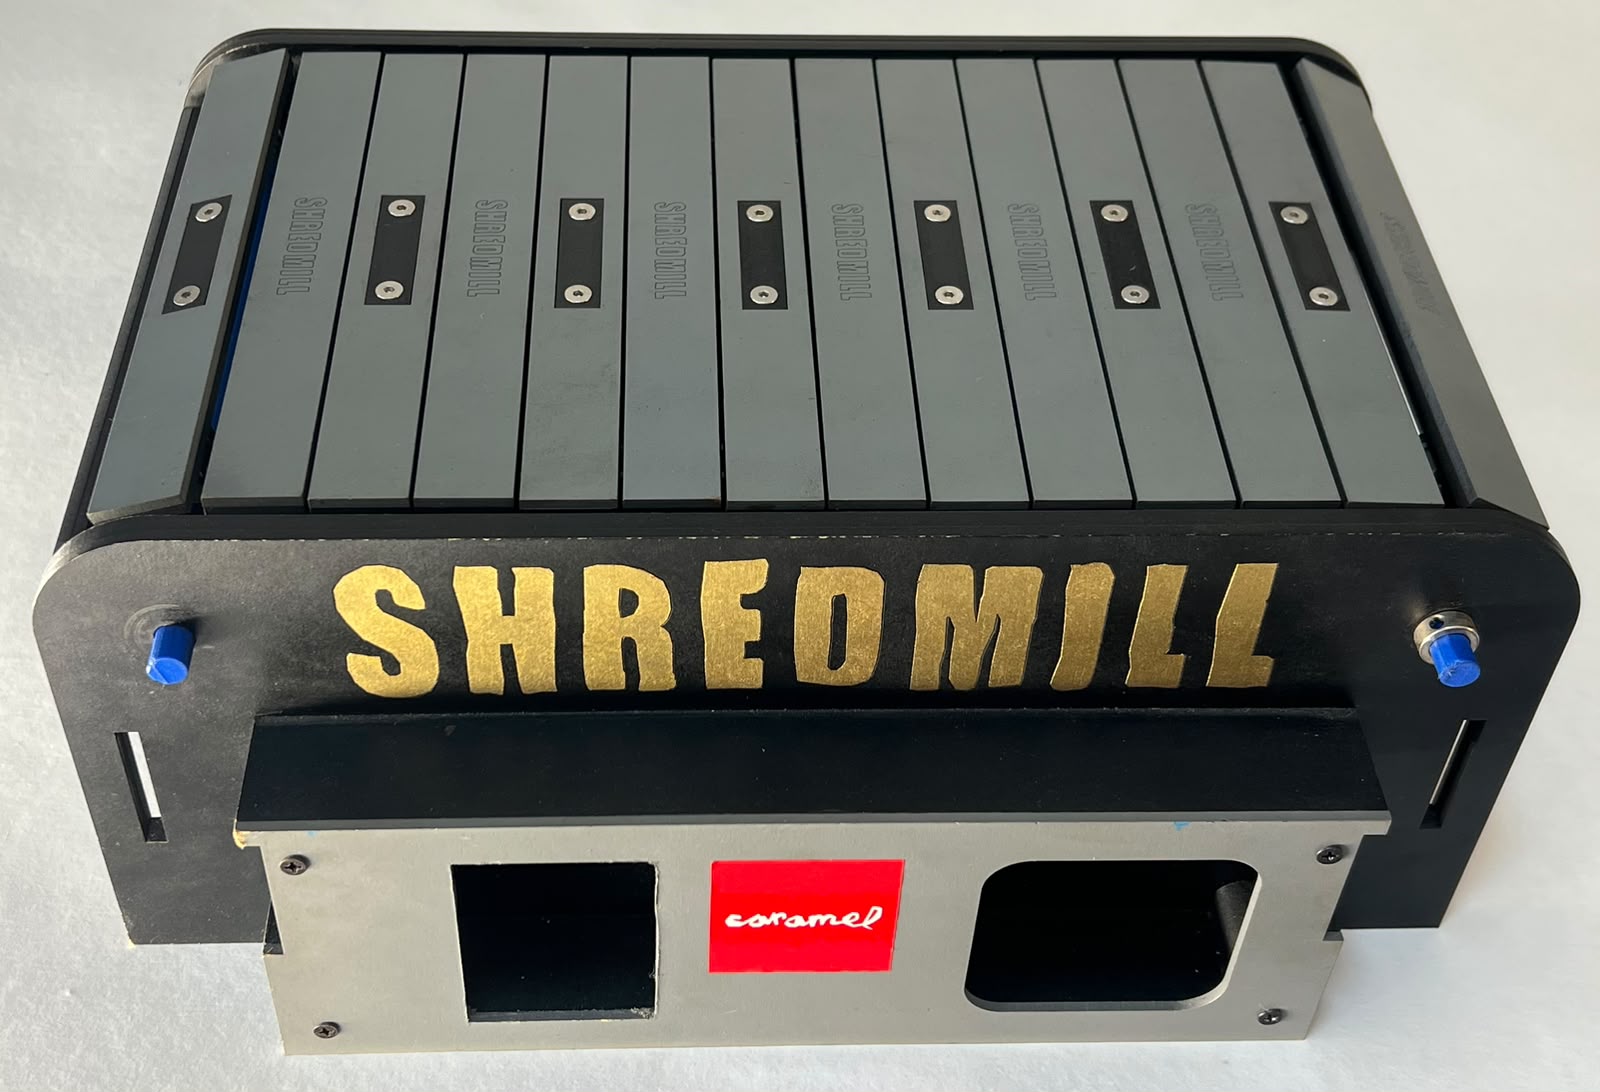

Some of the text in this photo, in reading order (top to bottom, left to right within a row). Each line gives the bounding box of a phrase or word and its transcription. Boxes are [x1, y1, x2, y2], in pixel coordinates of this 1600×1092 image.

[276, 196, 327, 296] SHREDMILL
[466, 199, 509, 298] SHREDMILL
[655, 201, 688, 300] SHREDMILL
[832, 203, 873, 302] SHREDMILL
[1008, 203, 1057, 302] SHREDMILL
[1187, 203, 1243, 303] SHREDMILL
[333, 558, 1279, 697] SHREDMILL
[724, 905, 883, 930] caramel
